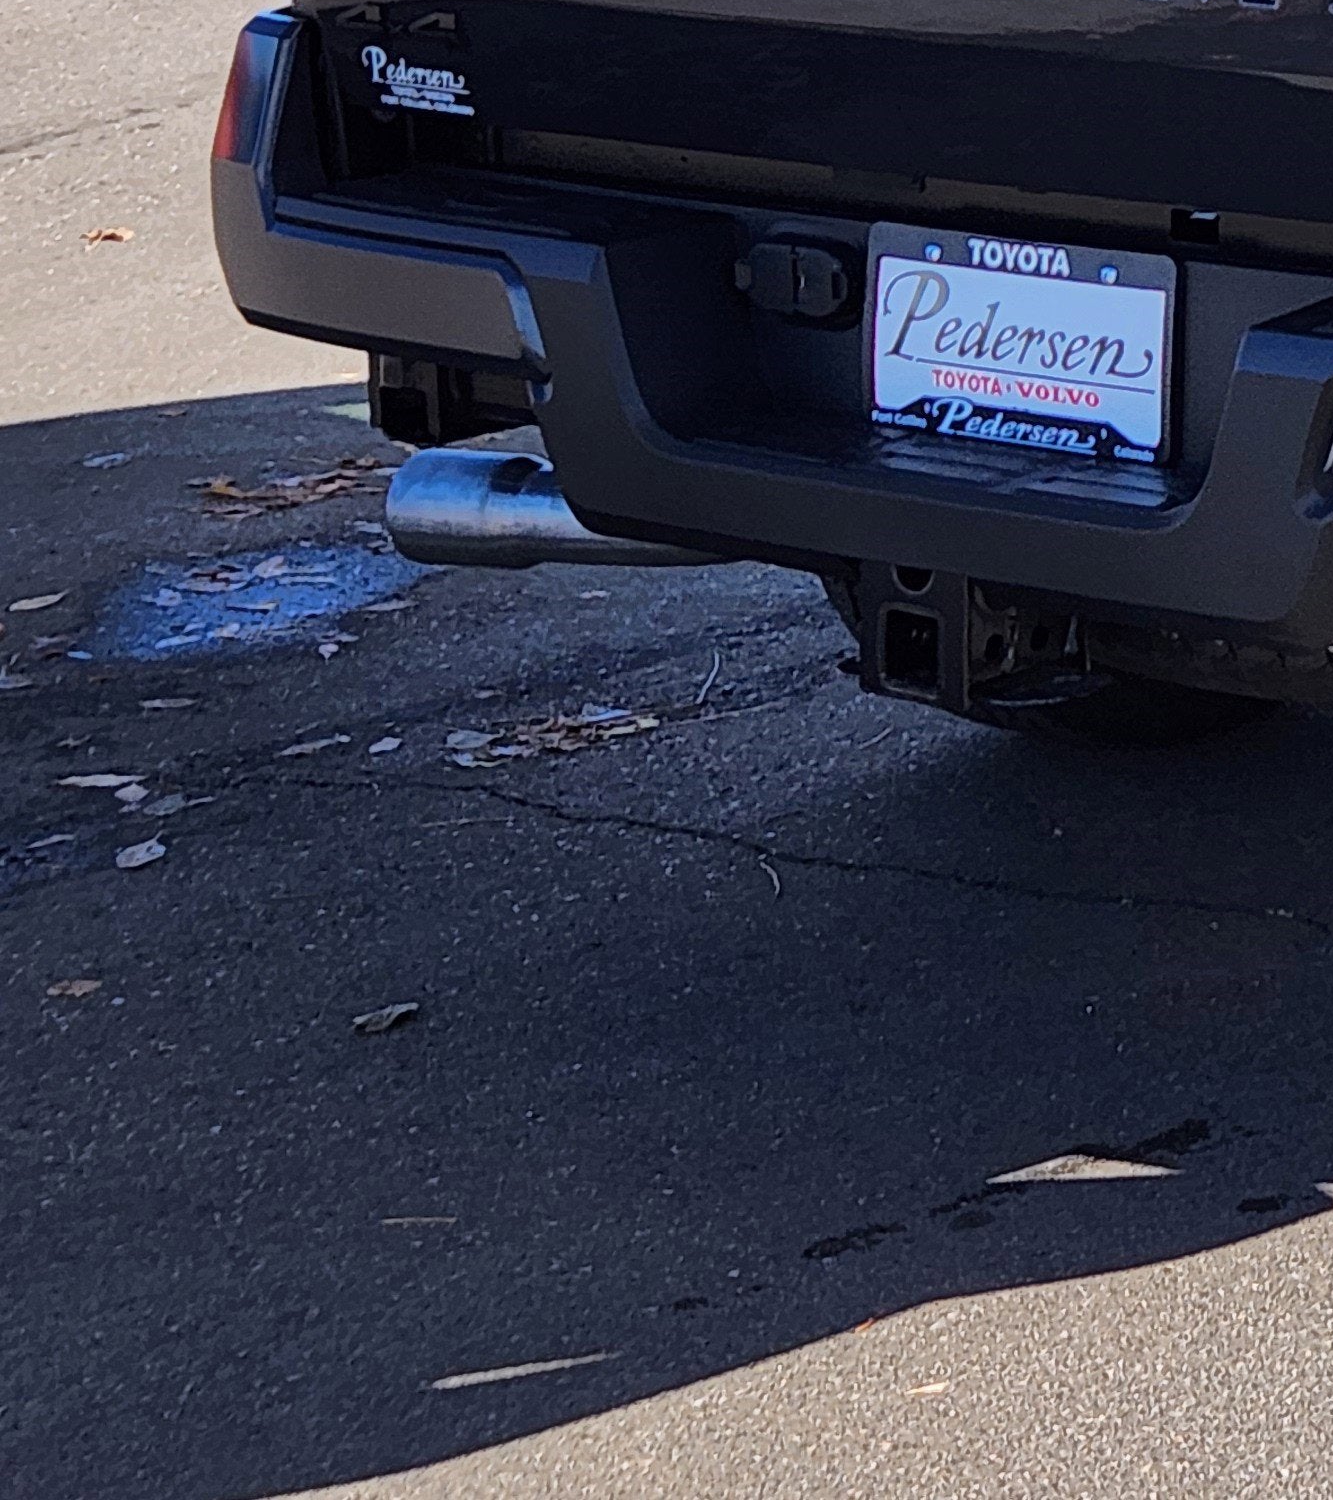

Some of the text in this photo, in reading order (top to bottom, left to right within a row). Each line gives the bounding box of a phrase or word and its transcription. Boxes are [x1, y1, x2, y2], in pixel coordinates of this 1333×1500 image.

[361, 45, 466, 90] Pedersen
[967, 237, 1071, 278] TOYOTA
[882, 269, 1154, 379] Pedersen
[931, 368, 1100, 409] TOYOTA VOLVO
[931, 396, 1097, 450] Pedersen
